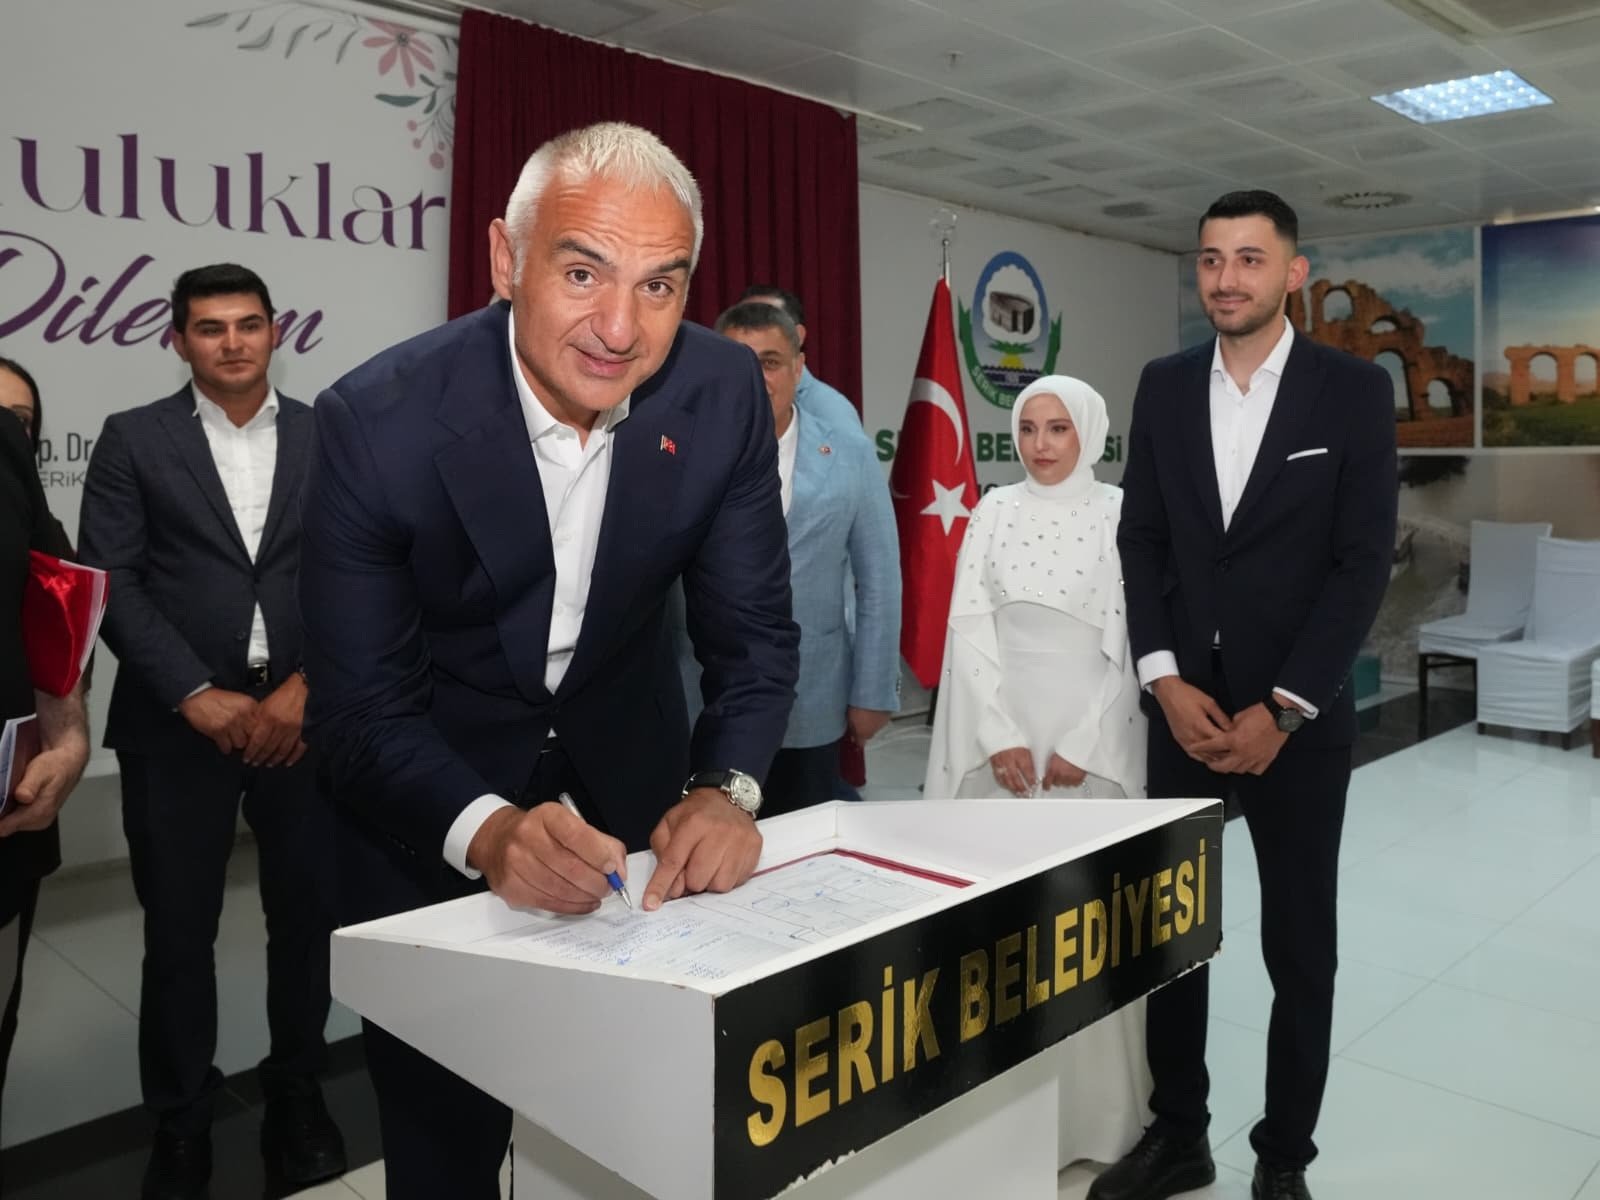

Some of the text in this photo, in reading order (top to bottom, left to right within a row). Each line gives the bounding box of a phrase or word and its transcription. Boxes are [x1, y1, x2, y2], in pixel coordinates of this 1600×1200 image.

[11, 133, 446, 251] uluklar
[39, 439, 59, 470] p.
[747, 838, 1206, 1148] SERİK BELEDİYESİ
